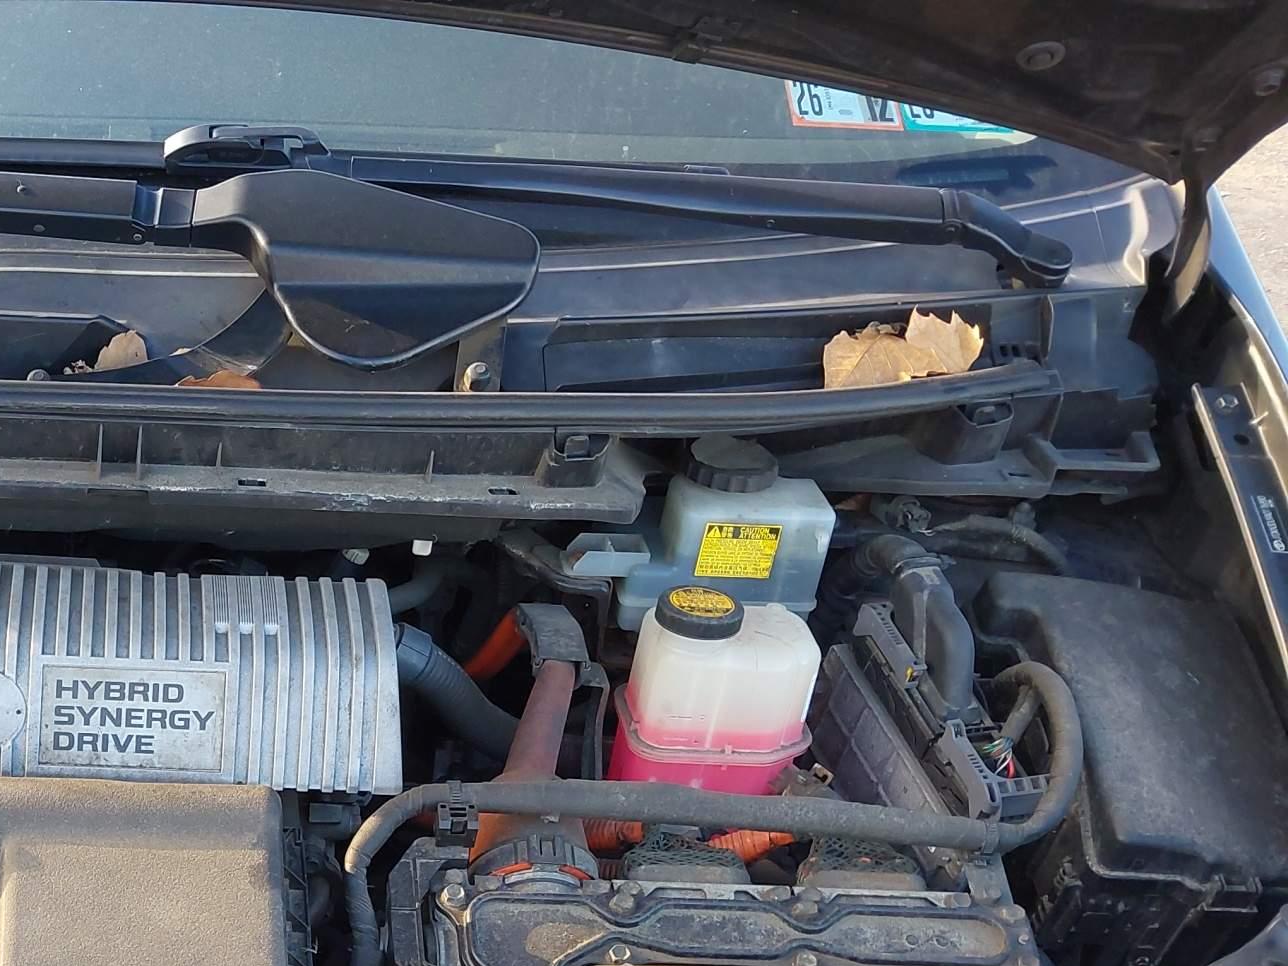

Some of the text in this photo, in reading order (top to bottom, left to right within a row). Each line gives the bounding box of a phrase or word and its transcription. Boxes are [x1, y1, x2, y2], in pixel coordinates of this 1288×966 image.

[740, 526, 770, 534] CAUTION
[55, 679, 184, 703] HYBRID
[53, 705, 215, 731] SYNERGY
[53, 732, 155, 755] DRIVE
